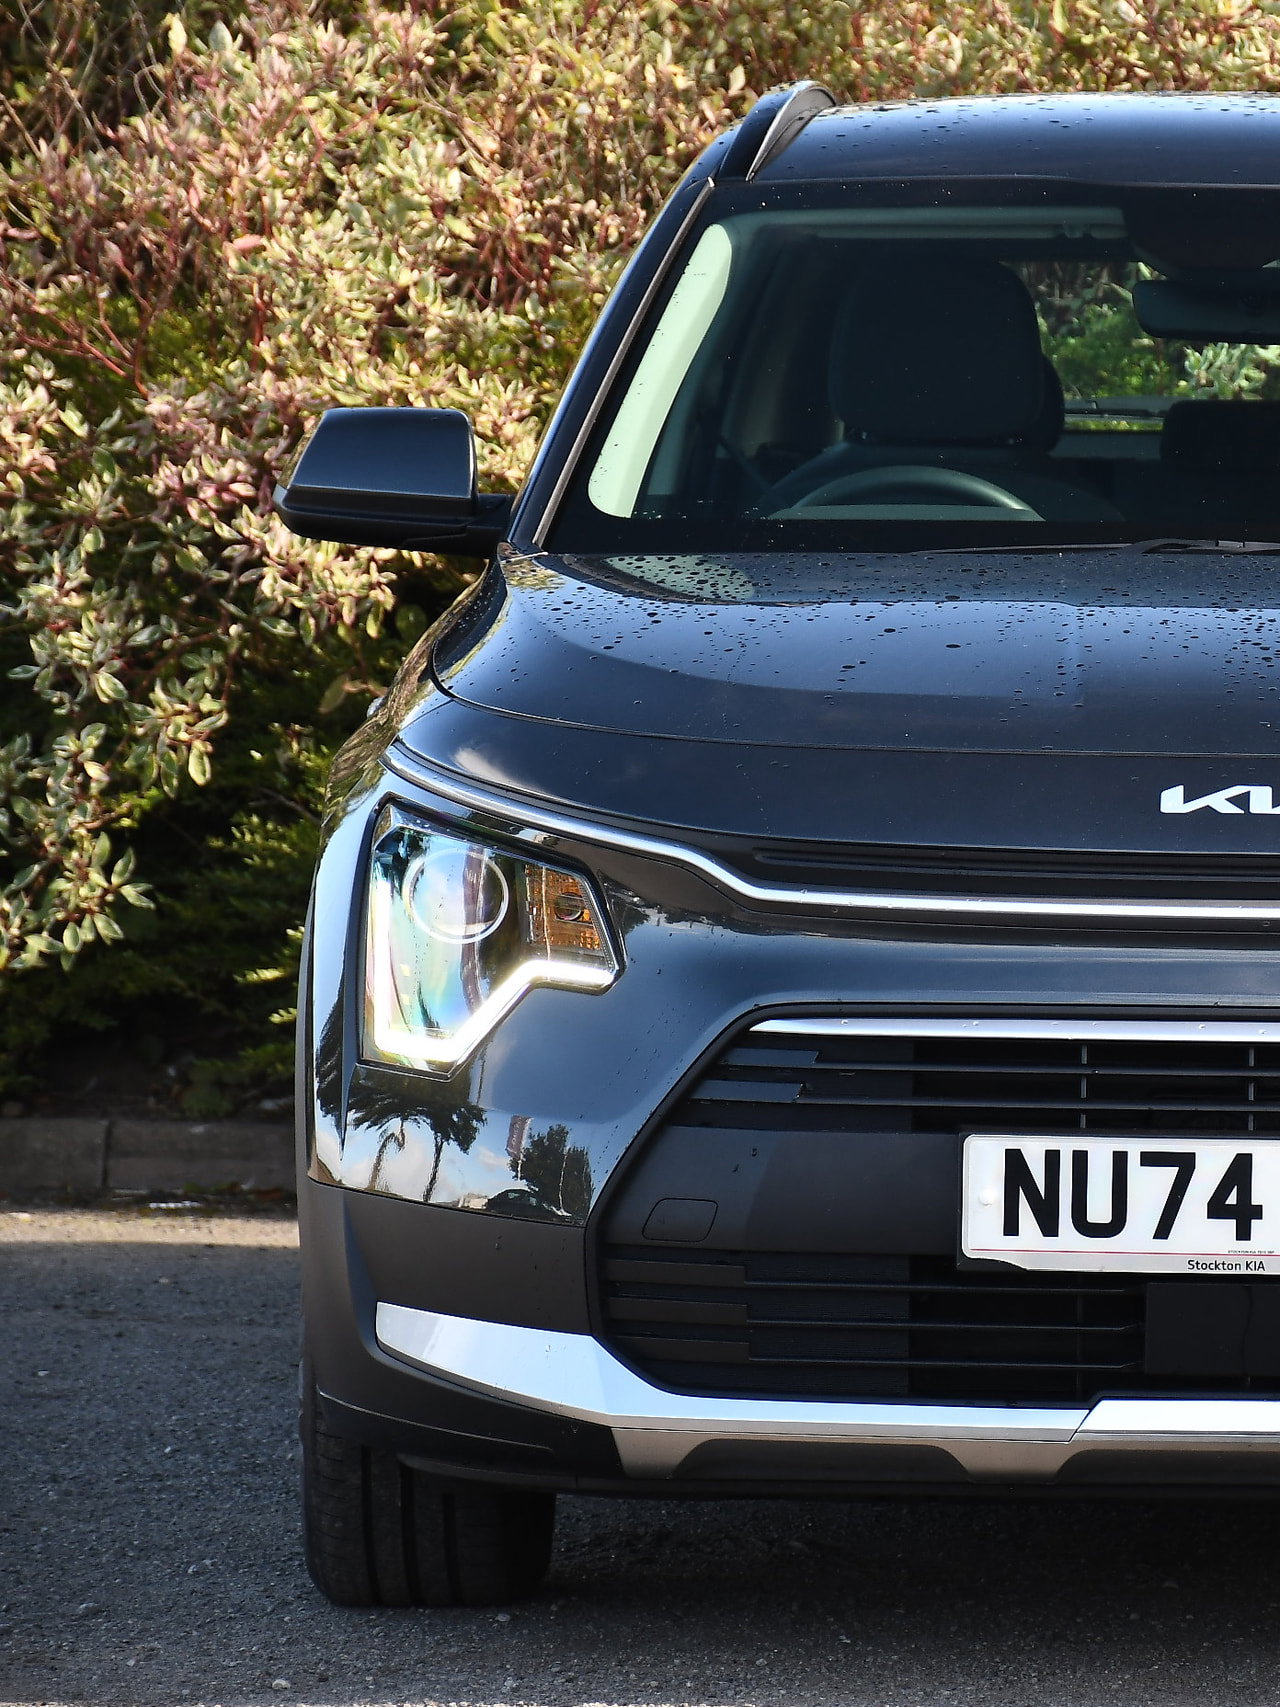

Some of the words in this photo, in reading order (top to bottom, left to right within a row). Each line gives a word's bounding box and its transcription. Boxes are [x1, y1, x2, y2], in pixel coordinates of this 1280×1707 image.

[1003, 1148, 1263, 1241] NU74
[1187, 1260, 1241, 1271] Stockton
[1245, 1261, 1266, 1272] KIA
